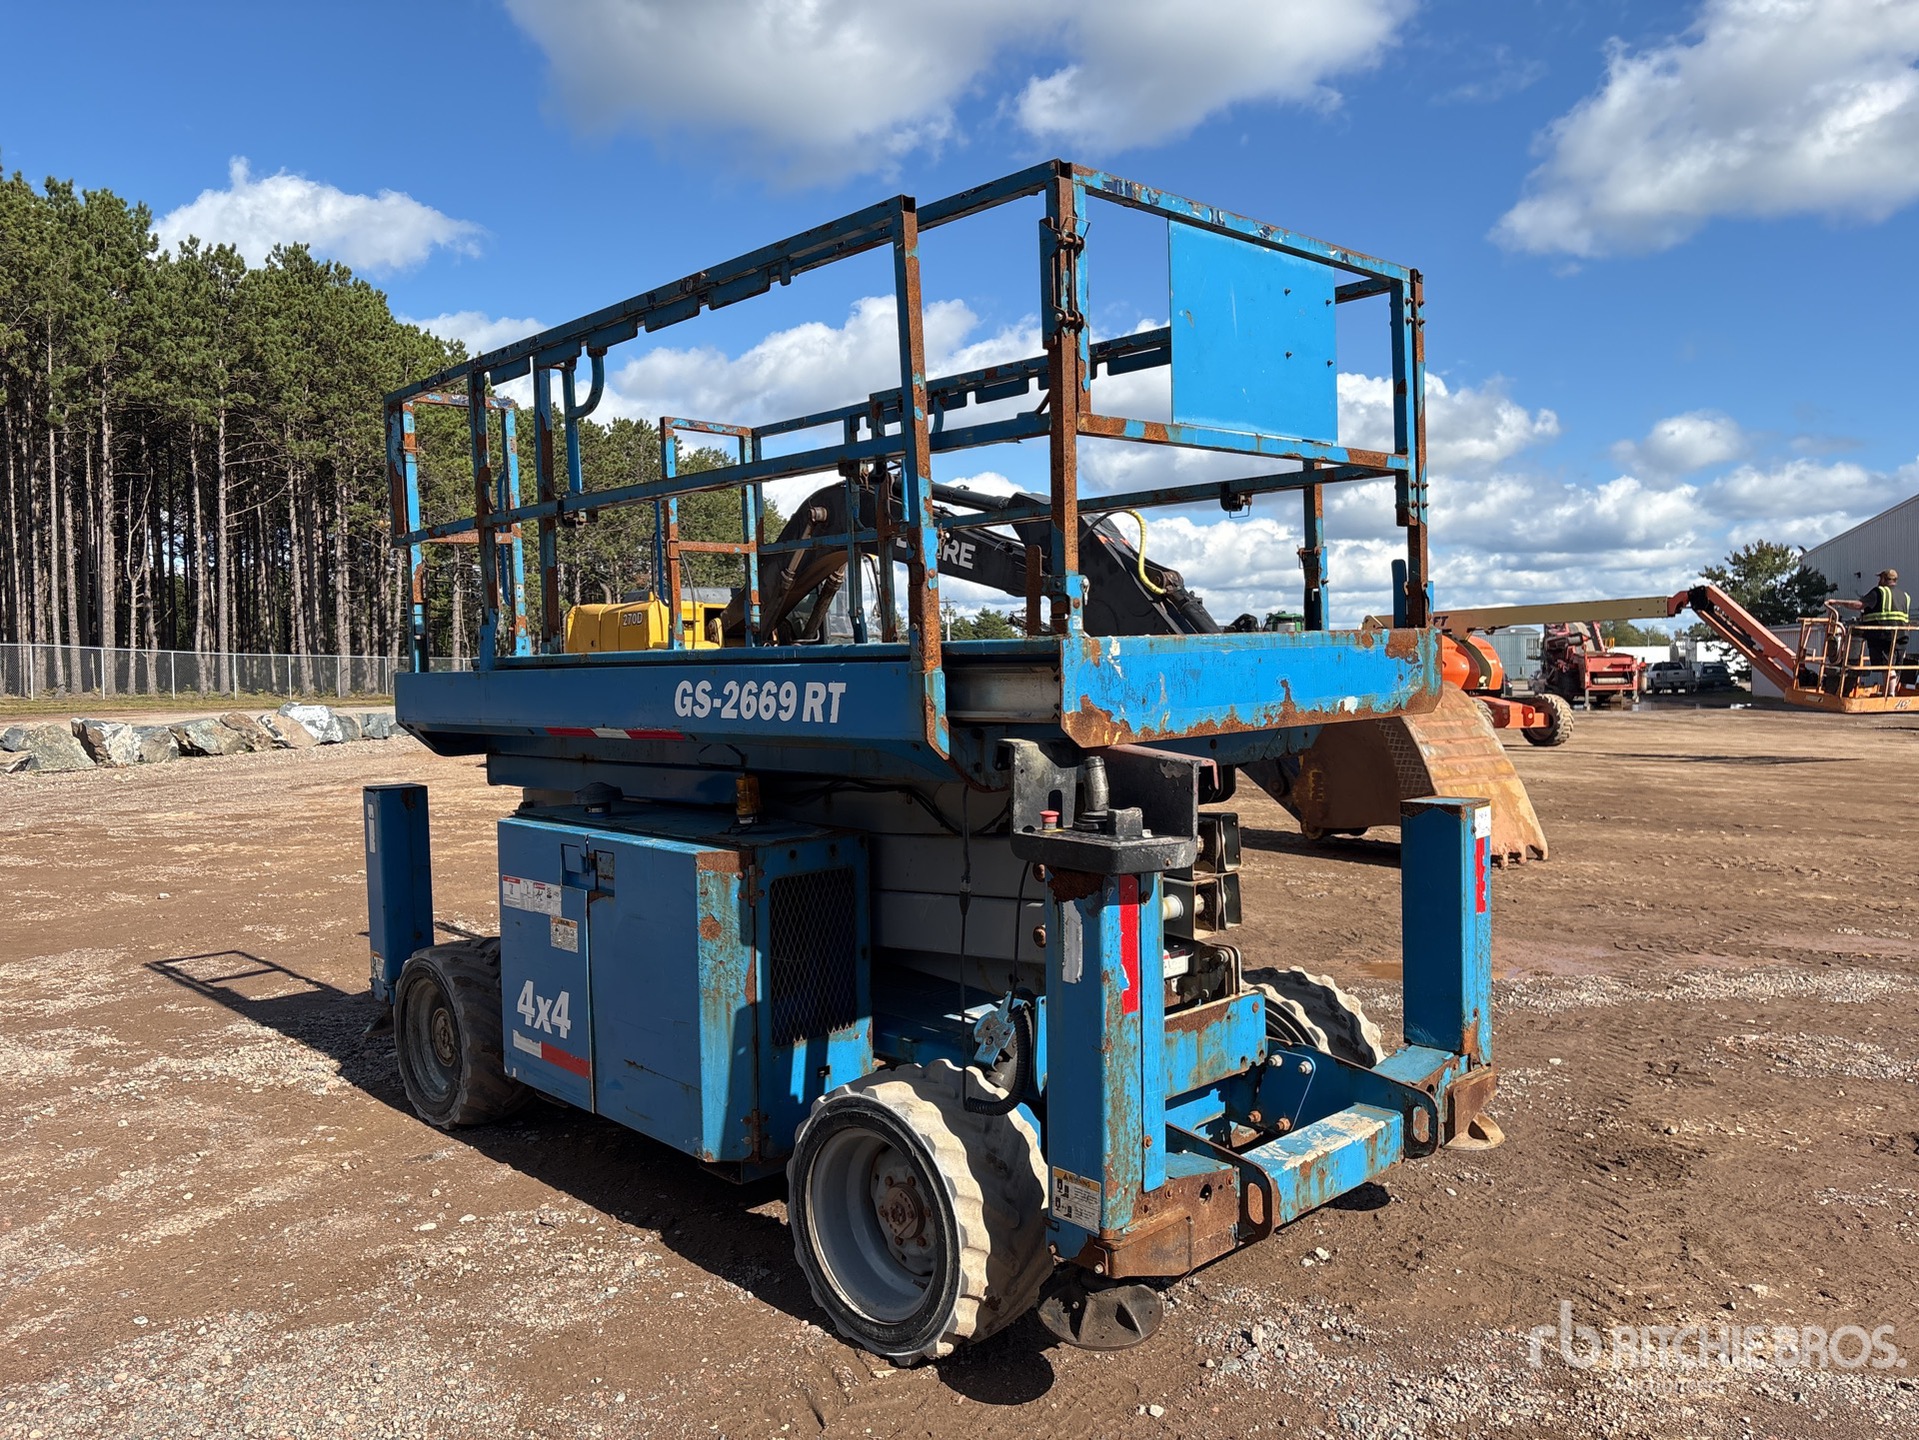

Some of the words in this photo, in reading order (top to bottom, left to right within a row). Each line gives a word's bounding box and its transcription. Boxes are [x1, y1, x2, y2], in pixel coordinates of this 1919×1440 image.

[623, 611, 643, 626] 270D
[674, 680, 798, 722] GS-2669
[802, 682, 847, 723] RT
[517, 979, 571, 1039] 4x4
